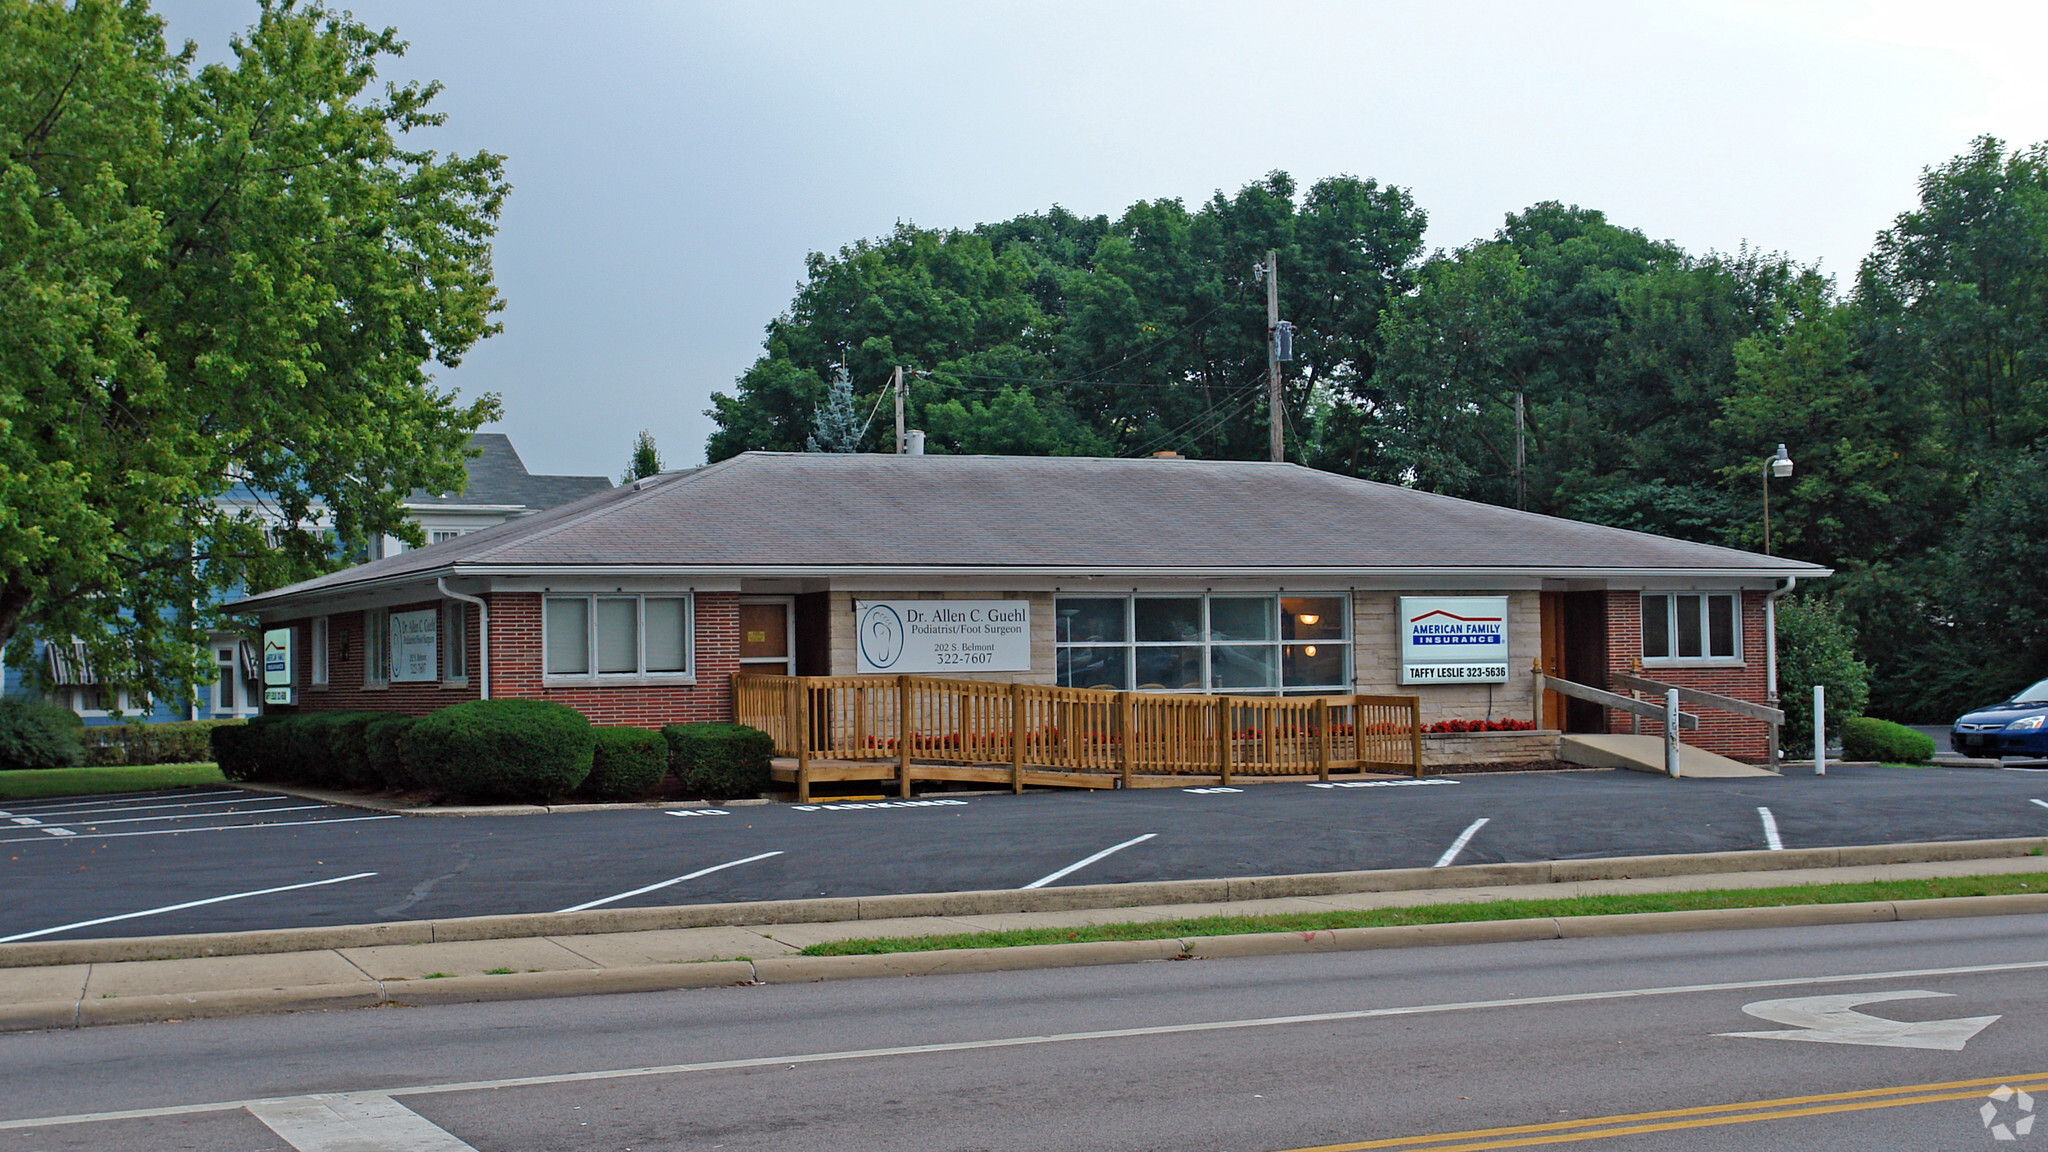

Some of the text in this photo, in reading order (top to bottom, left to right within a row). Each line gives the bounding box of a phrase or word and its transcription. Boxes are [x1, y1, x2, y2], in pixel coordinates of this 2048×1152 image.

[907, 609, 1026, 623] Dr. Allen C. Guehl
[911, 624, 1022, 636] Podiatrist/Foot Surgeon
[1413, 624, 1500, 634] AMERICAN FAMILY
[934, 643, 995, 652] 202 S. Belmont
[937, 653, 993, 664] 322-7607
[1410, 667, 1506, 678] TAFFY LESLIE 323-5636
[791, 799, 969, 811] PARKING
